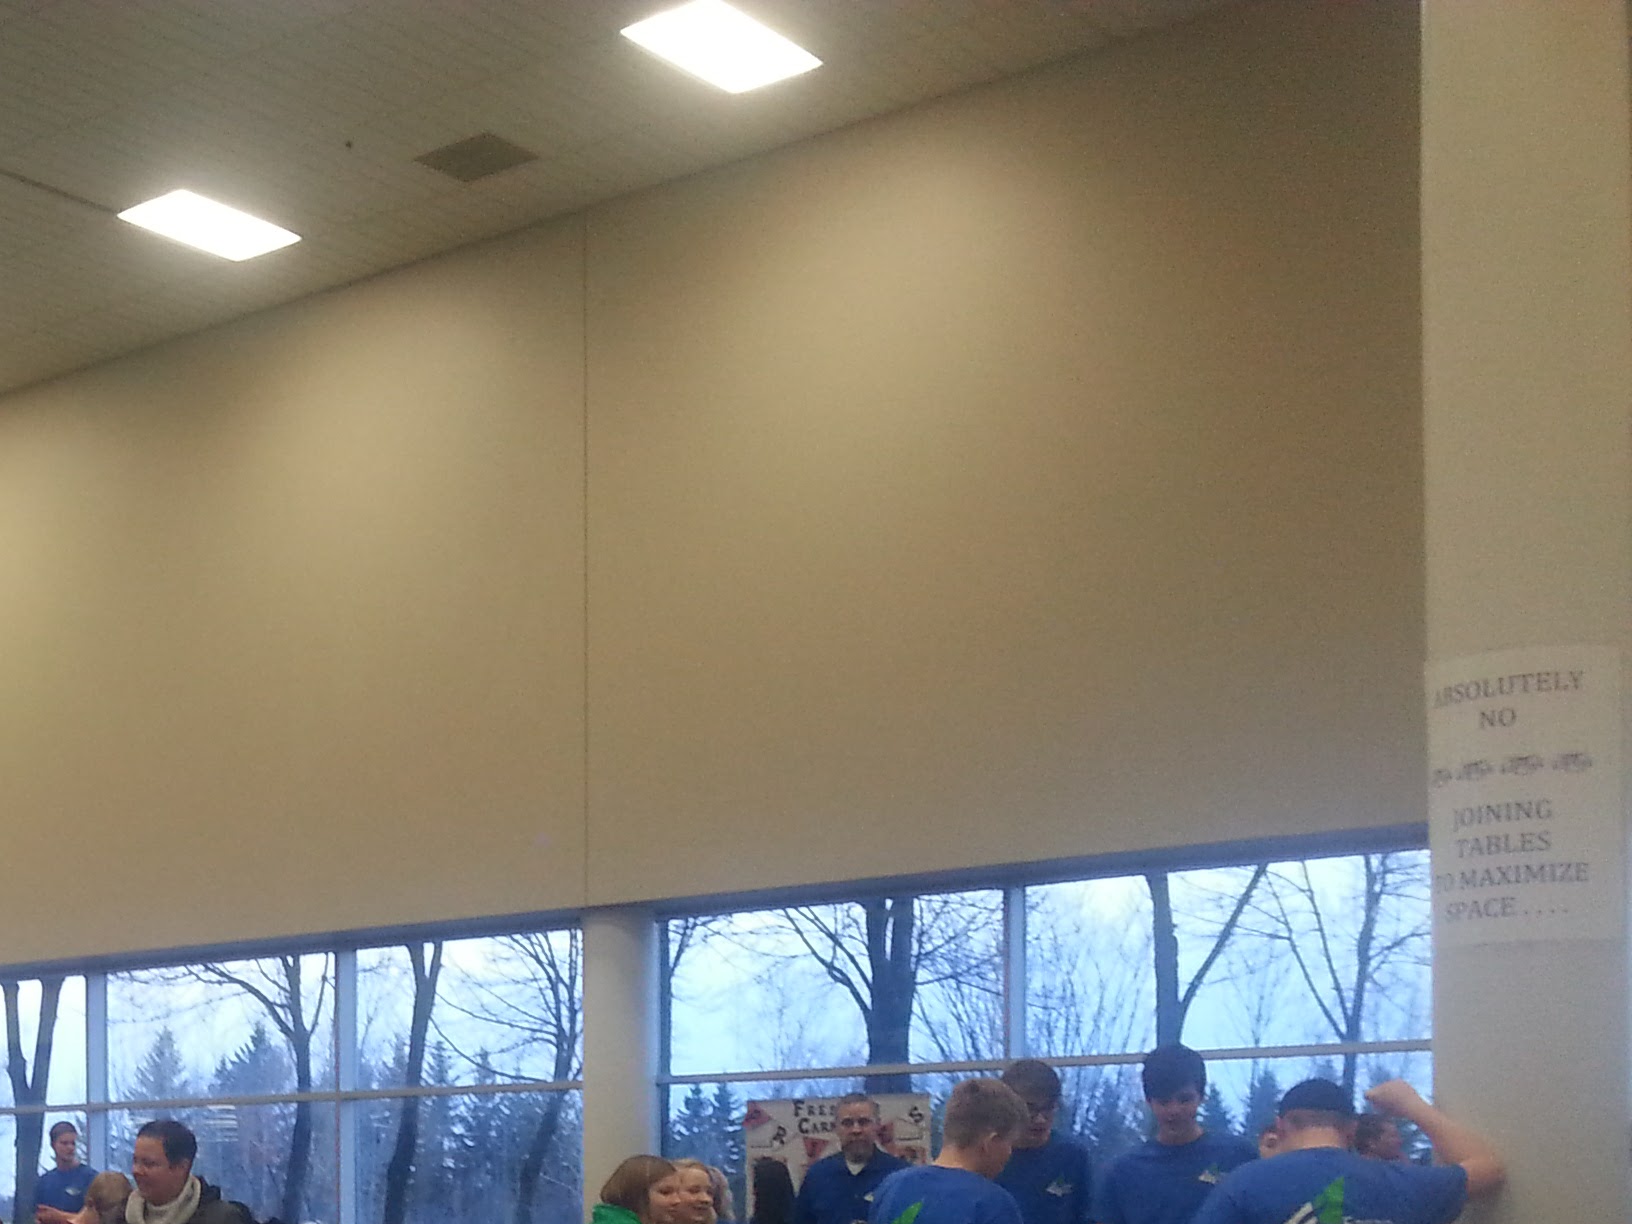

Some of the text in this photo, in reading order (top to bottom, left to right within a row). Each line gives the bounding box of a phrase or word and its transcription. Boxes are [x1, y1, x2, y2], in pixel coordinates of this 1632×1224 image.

[1479, 708, 1517, 729] NO
[1456, 831, 1552, 859] TABLES
[1459, 862, 1590, 892] MAXIMIZE
